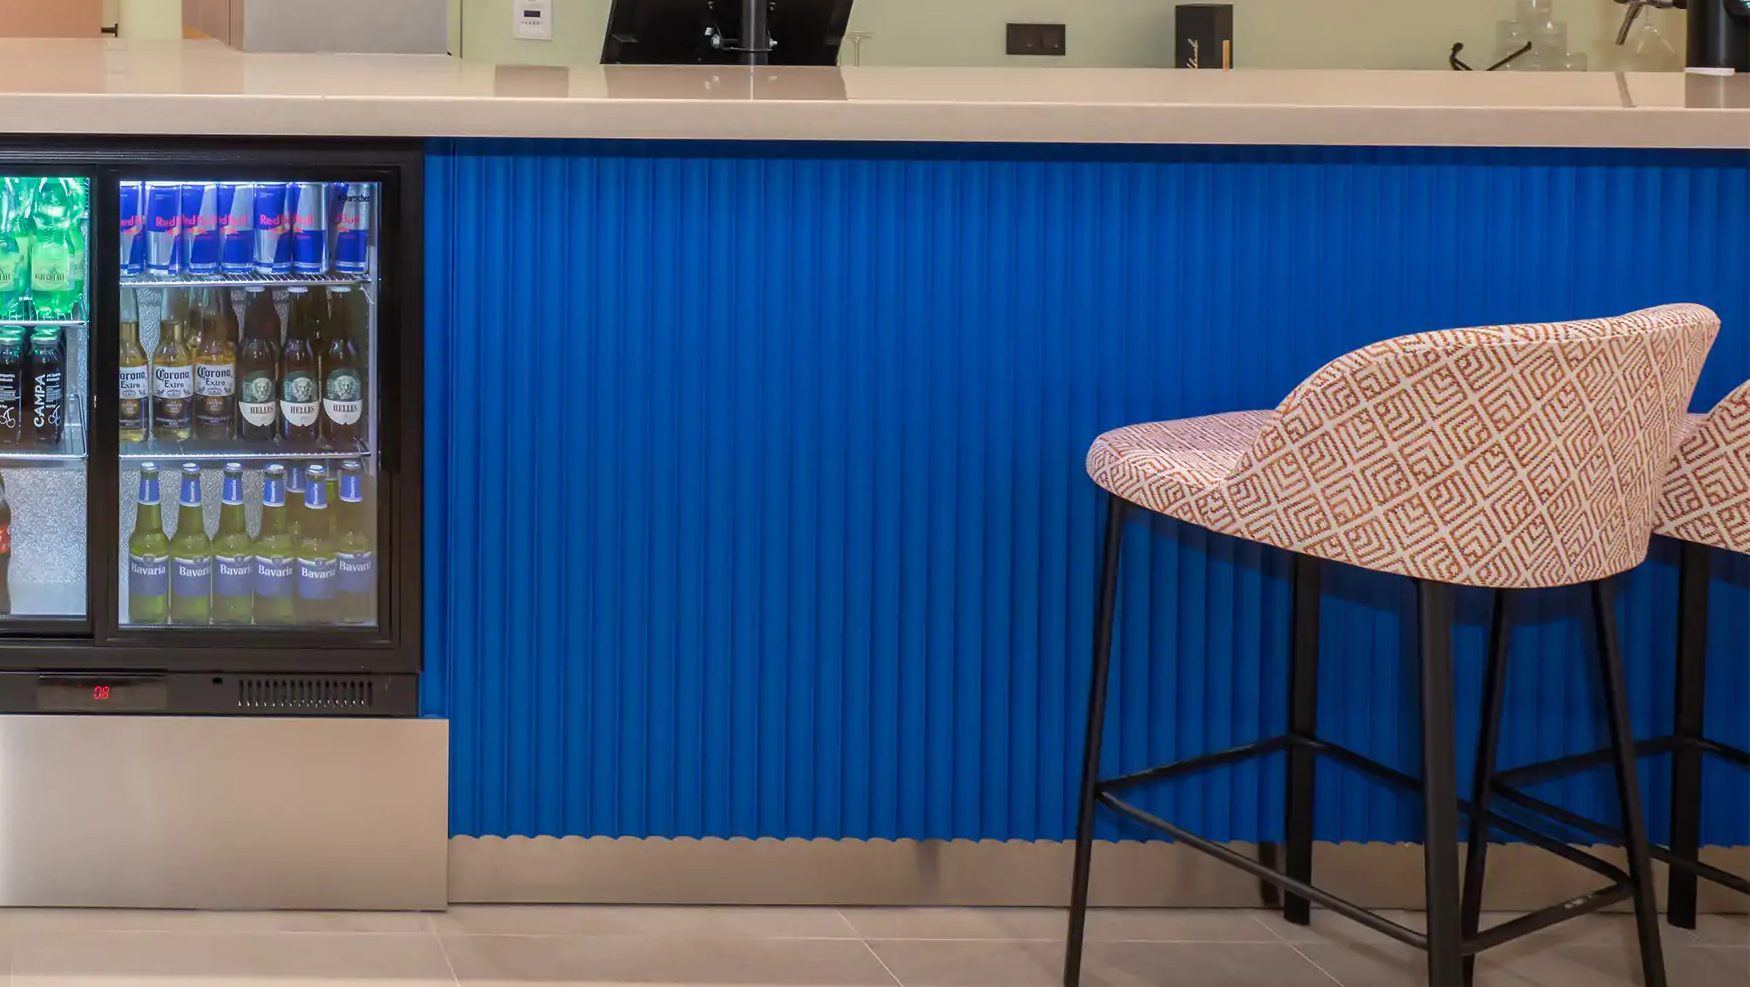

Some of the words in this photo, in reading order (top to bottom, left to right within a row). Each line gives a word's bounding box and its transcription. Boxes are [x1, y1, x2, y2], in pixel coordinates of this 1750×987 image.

[155, 216, 176, 228] Red
[259, 215, 281, 226] Red
[155, 368, 189, 382] Corona
[197, 366, 231, 380] Corona
[120, 380, 140, 389] Extra
[164, 380, 184, 390] Extra
[205, 377, 226, 387] Extra
[33, 374, 46, 428] CAMPA
[131, 561, 167, 576] Bavaria
[93, 685, 110, 700] 08
